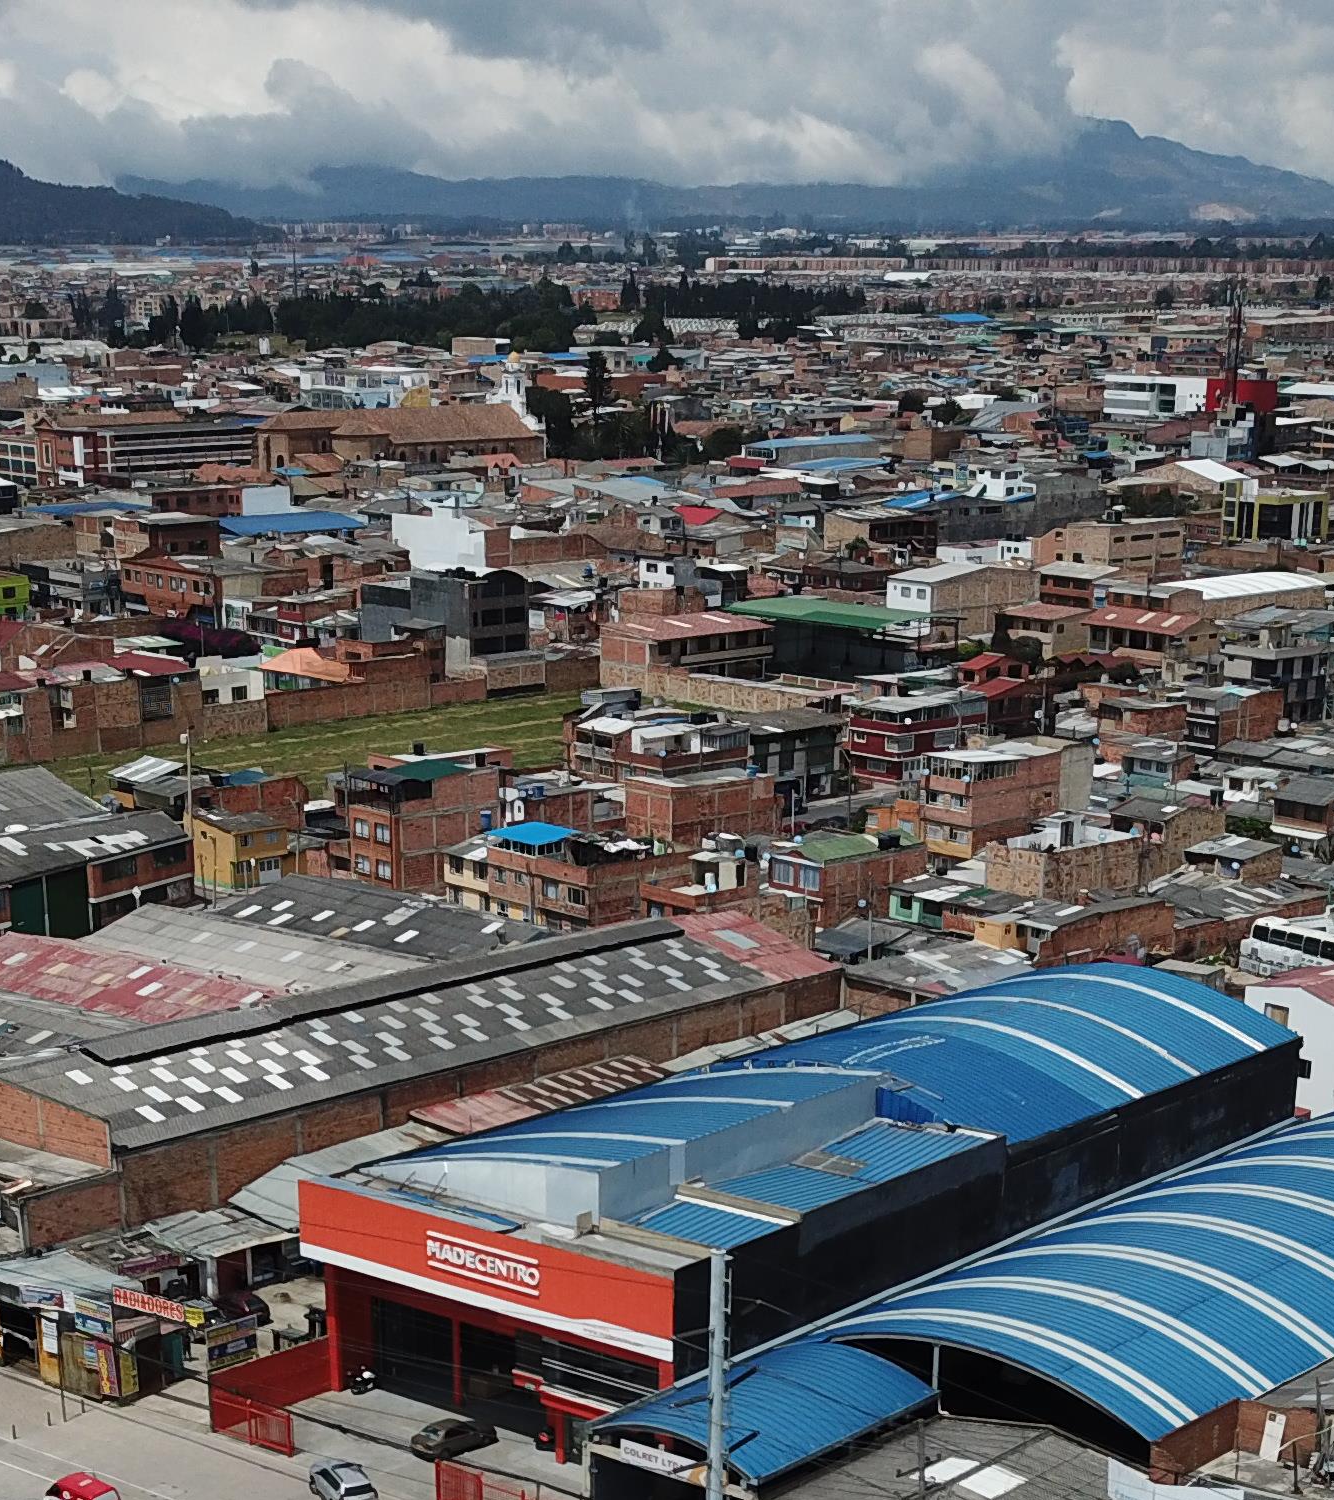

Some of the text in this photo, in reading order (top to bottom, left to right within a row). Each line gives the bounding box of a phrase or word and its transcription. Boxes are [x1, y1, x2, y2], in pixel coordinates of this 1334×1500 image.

[426, 1238, 540, 1287] MADECENTRO
[113, 1287, 185, 1321] RADIADORES
[623, 1446, 659, 1464] COLRET
